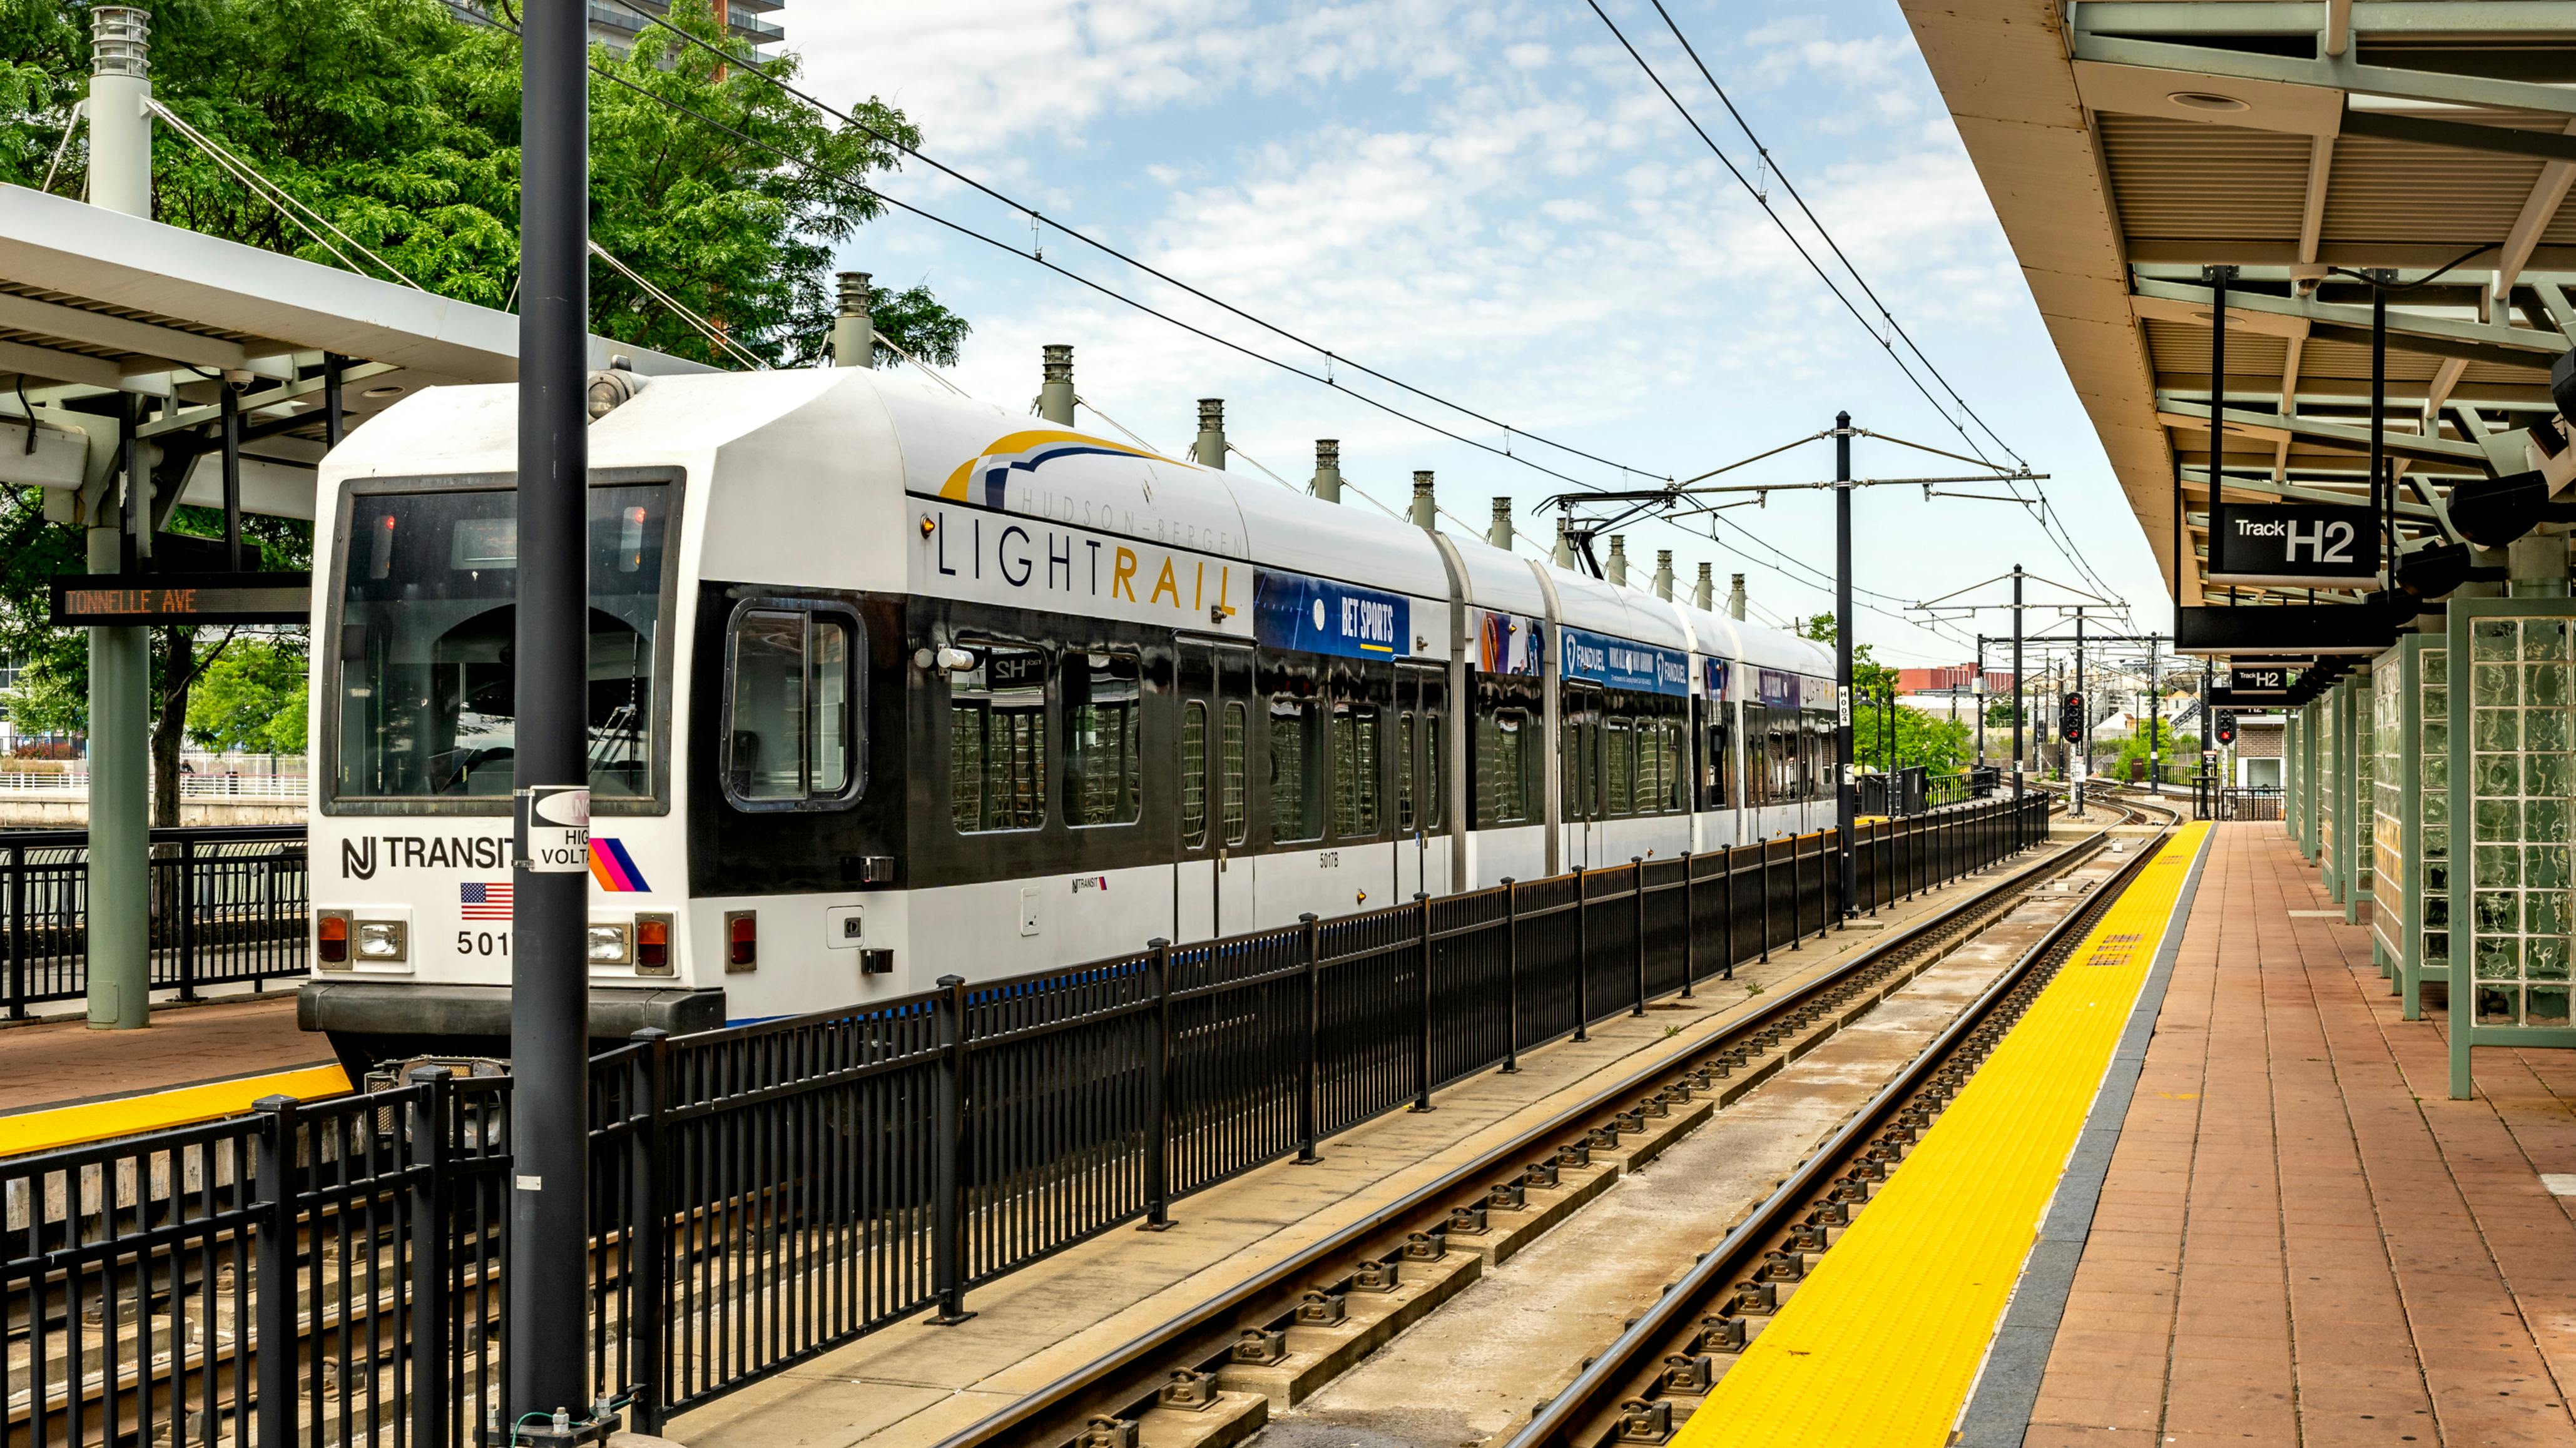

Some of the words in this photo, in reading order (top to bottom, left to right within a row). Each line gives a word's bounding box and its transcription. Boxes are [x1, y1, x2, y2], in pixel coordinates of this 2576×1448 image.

[1023, 487, 1241, 559] HUDSON-BERGEN
[2236, 519, 2285, 536] Track
[2286, 520, 2355, 563] H2
[65, 590, 151, 614] TONNELLE
[163, 589, 197, 613] AVE
[1341, 596, 1359, 637] BET
[1360, 599, 1393, 643] SPORTS
[1577, 645, 1606, 672] FANDUEL
[1664, 661, 1686, 684] FANDUEL
[2256, 672, 2279, 687] H2
[342, 836, 376, 880] NJ
[541, 849, 589, 864] VOLT
[1320, 851, 1338, 868] 5017B
[1077, 877, 1097, 888] TRANSIT
[457, 931, 513, 956] 501
